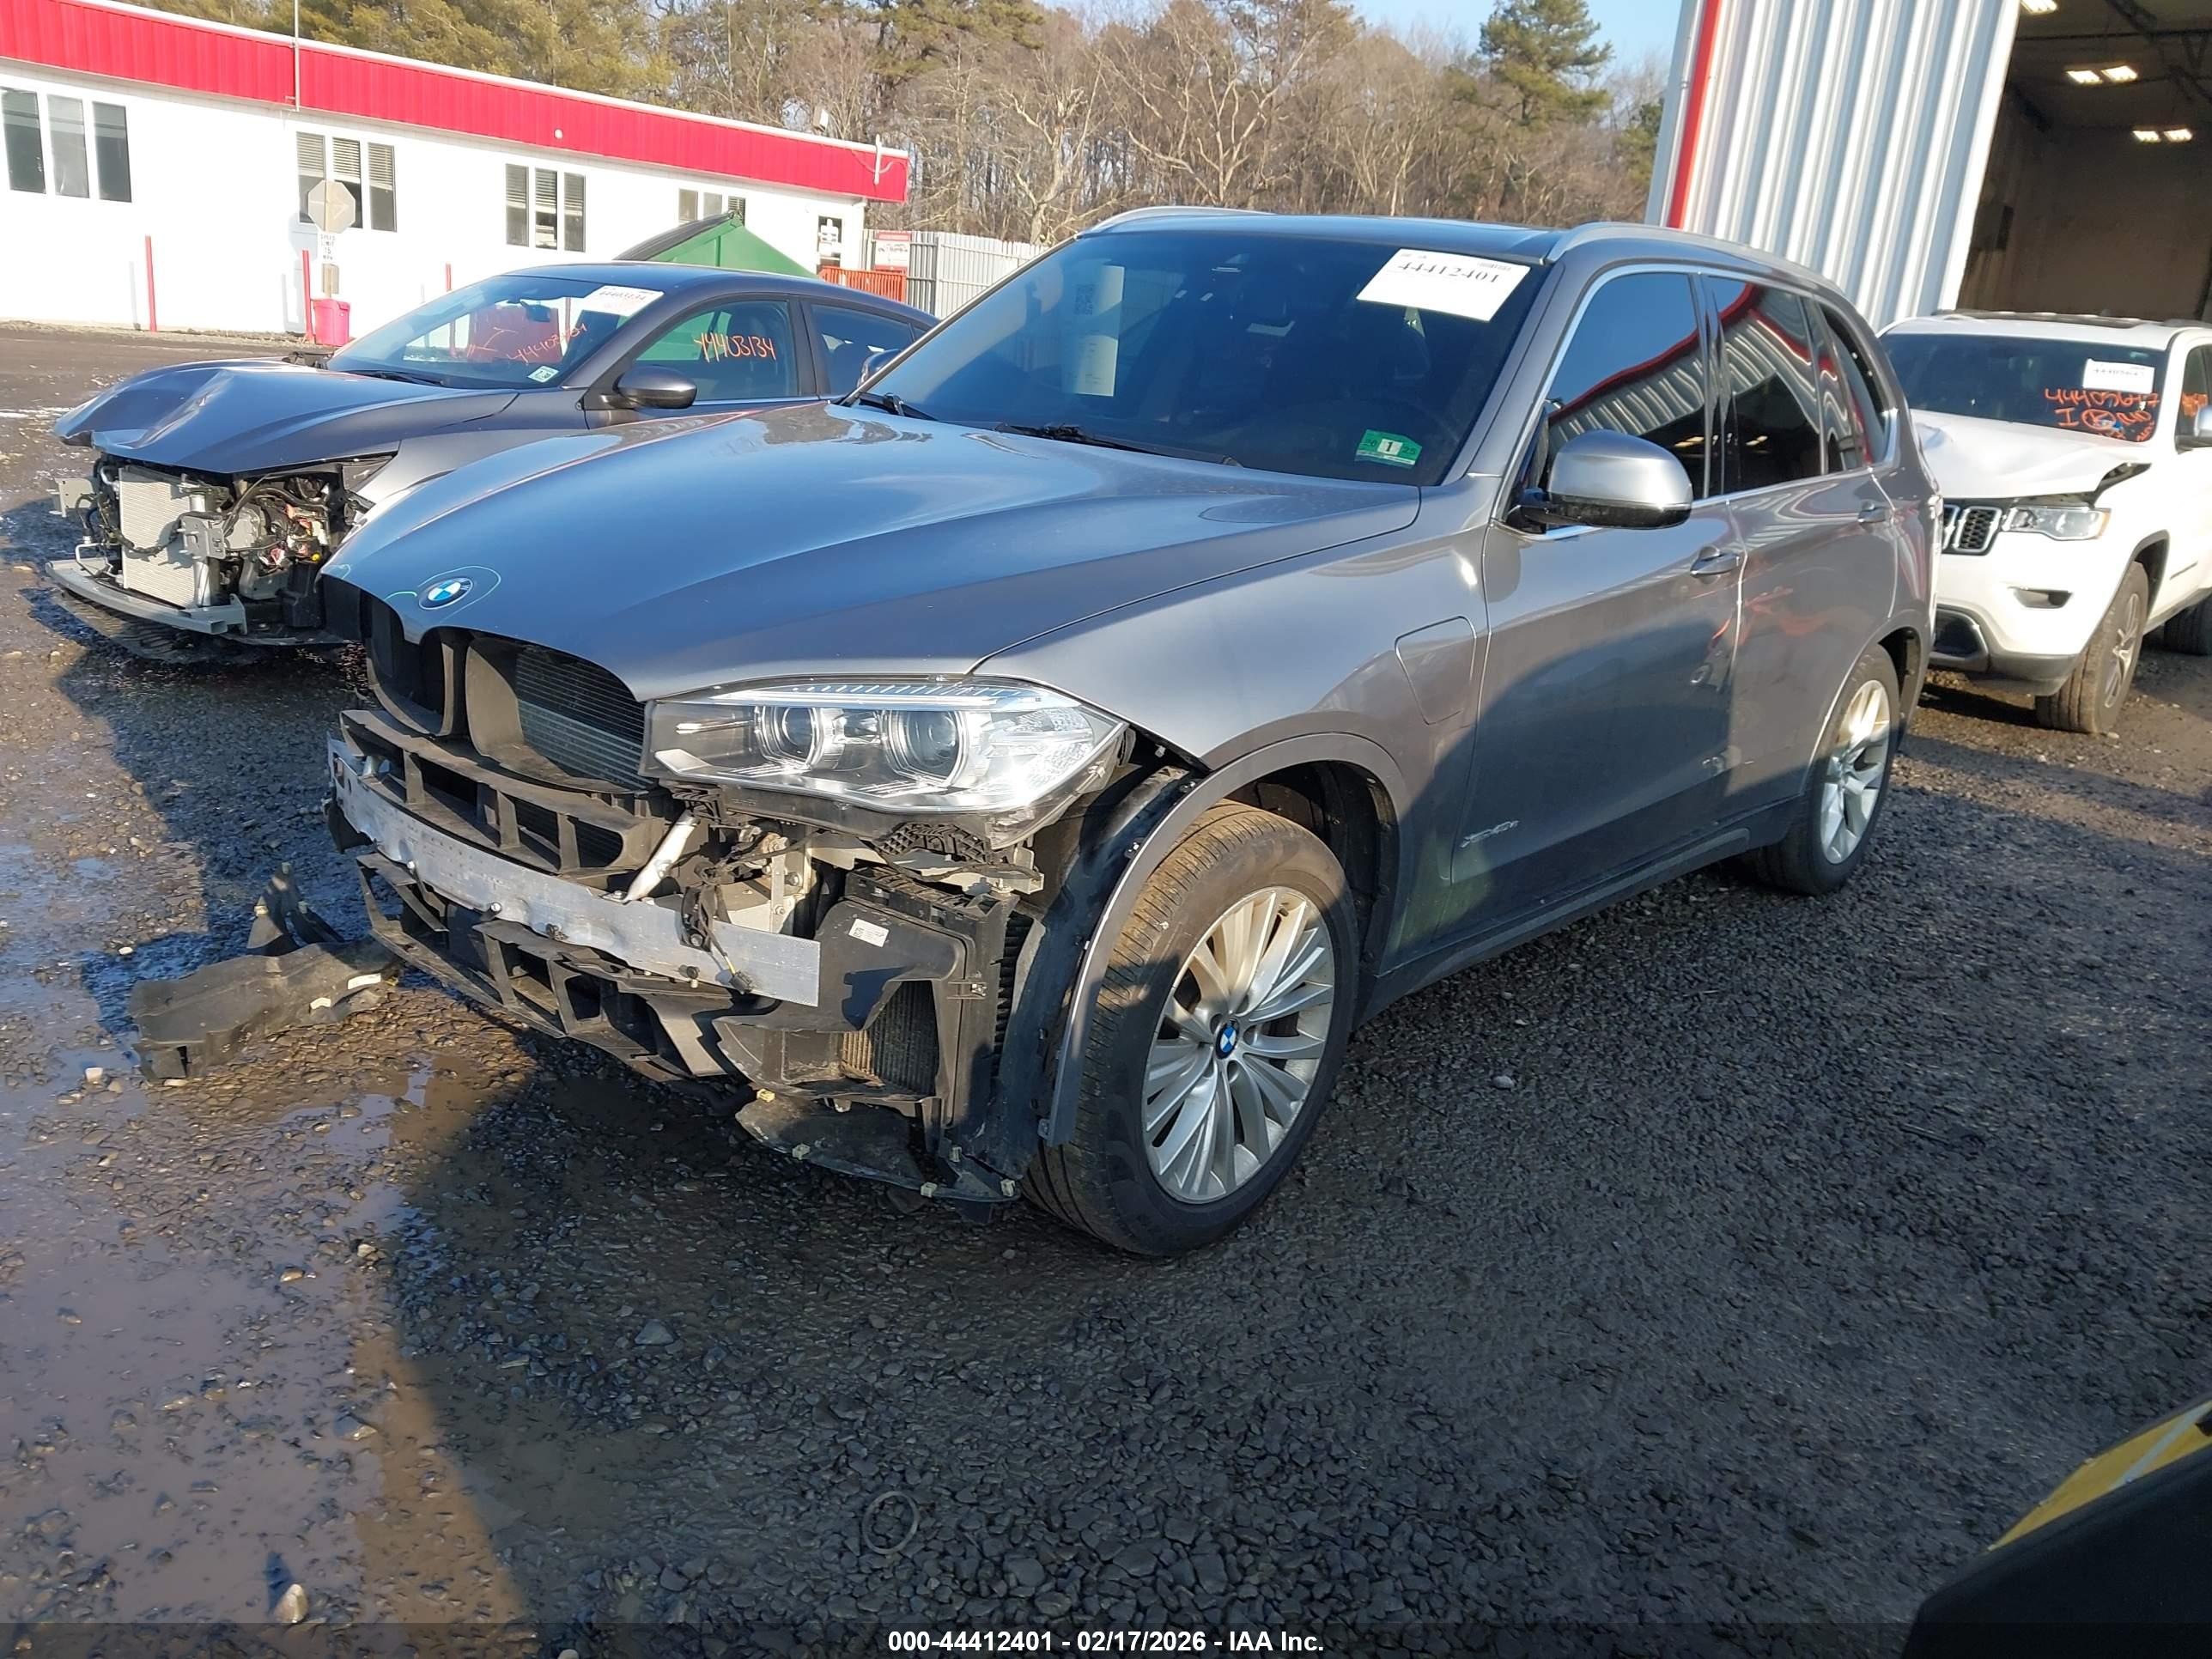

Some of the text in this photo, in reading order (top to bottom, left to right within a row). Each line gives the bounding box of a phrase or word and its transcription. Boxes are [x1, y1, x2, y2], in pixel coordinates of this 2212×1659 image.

[1398, 261, 1500, 283] 44412401
[693, 331, 777, 363] 44403134
[1385, 441, 1395, 453] 1
